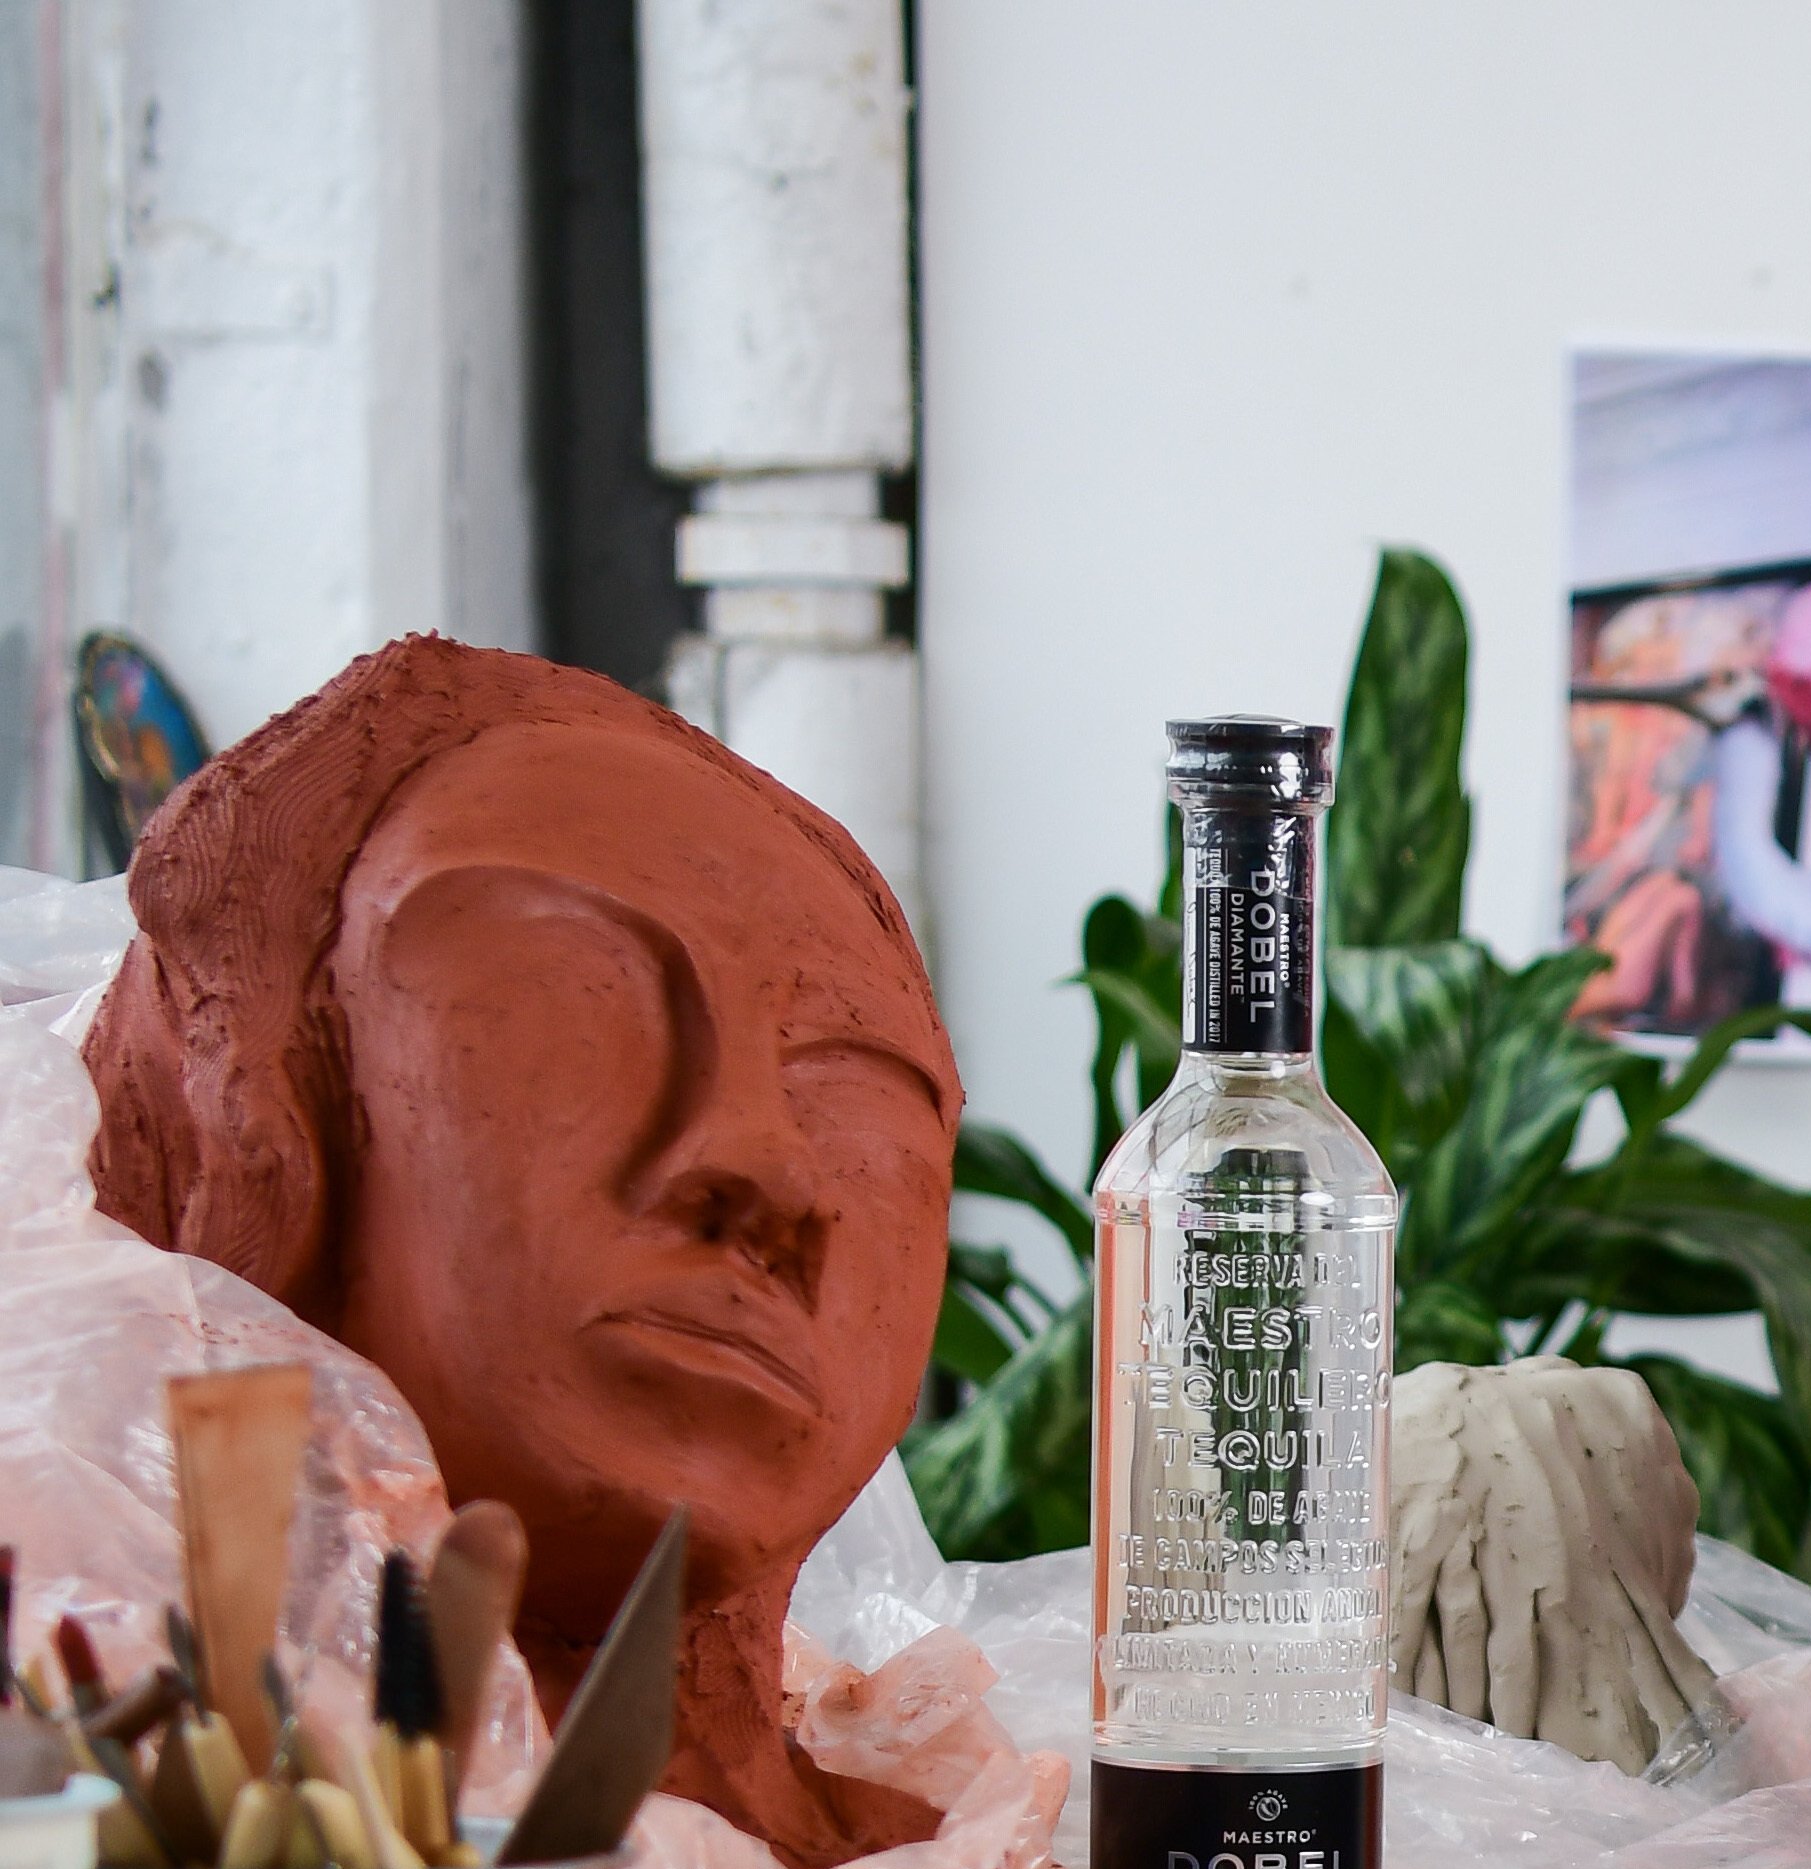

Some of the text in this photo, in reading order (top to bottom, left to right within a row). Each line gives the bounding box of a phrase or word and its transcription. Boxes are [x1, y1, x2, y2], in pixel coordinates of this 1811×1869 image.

[1209, 888, 1222, 914] 100%
[1209, 917, 1222, 929] DE
[1209, 930, 1222, 959] AGAVE
[1230, 892, 1245, 996] DIAMANTE
[1250, 869, 1276, 1023] DOBEL
[1280, 912, 1291, 982] MAESTRO
[1209, 961, 1222, 1007] DISTILLED
[1209, 1009, 1222, 1019] IN
[1209, 1021, 1222, 1044] 2017
[1173, 1251, 1306, 1288] RESERVA
[1139, 1303, 1383, 1350] MAESTRO
[1156, 1426, 1370, 1470] TEQUILA
[1247, 1489, 1288, 1526] DE
[1154, 1536, 1280, 1574] CAMPOS
[1223, 1830, 1311, 1844] MAESTRO
